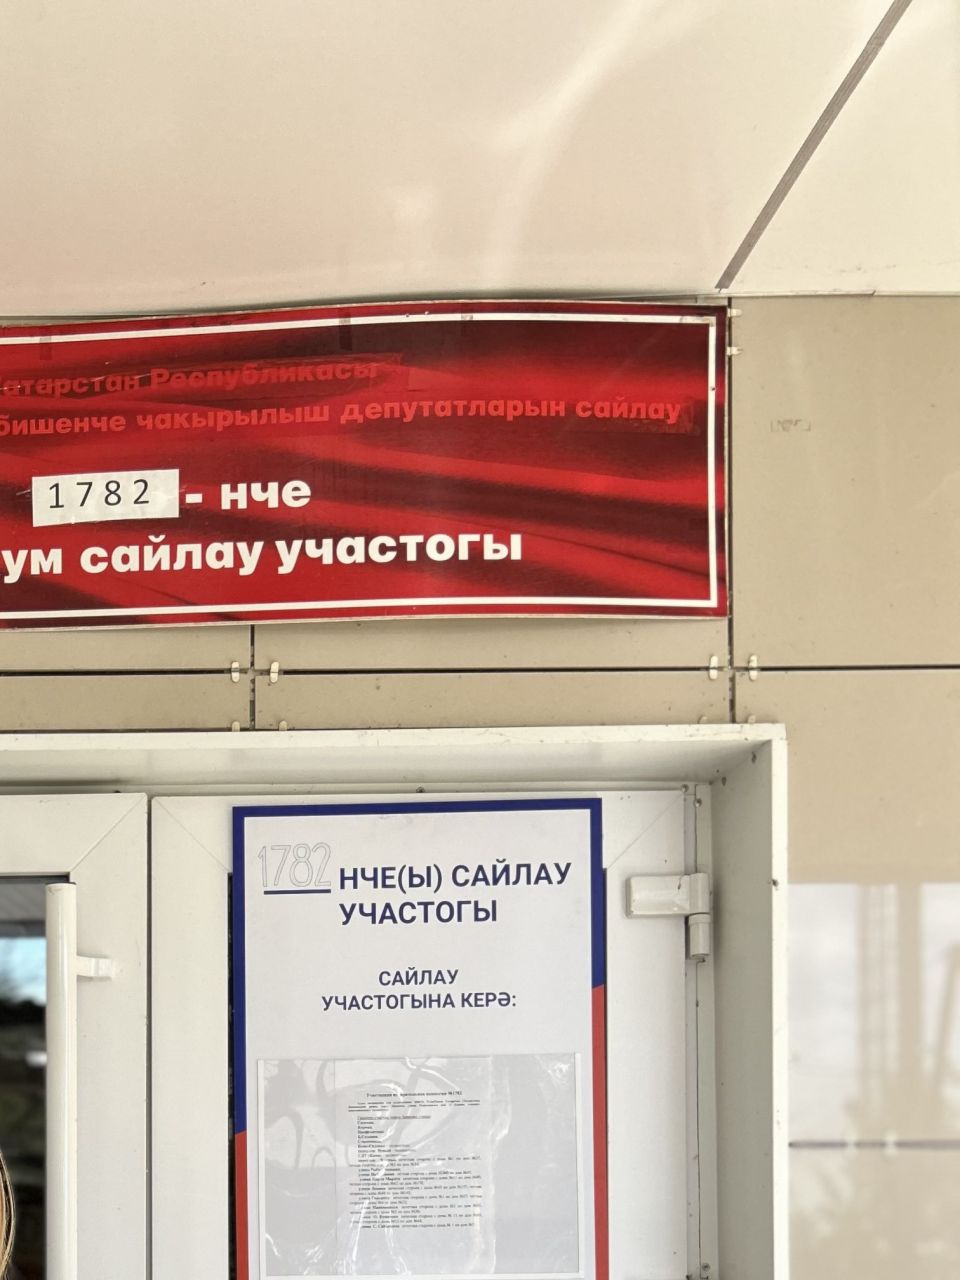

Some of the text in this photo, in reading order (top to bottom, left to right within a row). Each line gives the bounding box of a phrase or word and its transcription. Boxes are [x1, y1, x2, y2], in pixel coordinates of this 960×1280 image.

[150, 361, 378, 391] Республикасы
[136, 405, 330, 432] чакырылыш
[340, 398, 566, 424] депутатларын
[575, 396, 682, 424] сайлау
[48, 478, 150, 508] 1782
[80, 534, 264, 576] сайлау
[274, 532, 522, 575] участогы
[257, 842, 572, 894] 1782 НЧЕ(Ы) САЙЛАУ
[339, 899, 498, 926] УЧАСТОГЫ
[378, 966, 459, 987] САЙЛАУ
[322, 991, 517, 1011] УЧАСТОГЫНА КЕРӘ:
